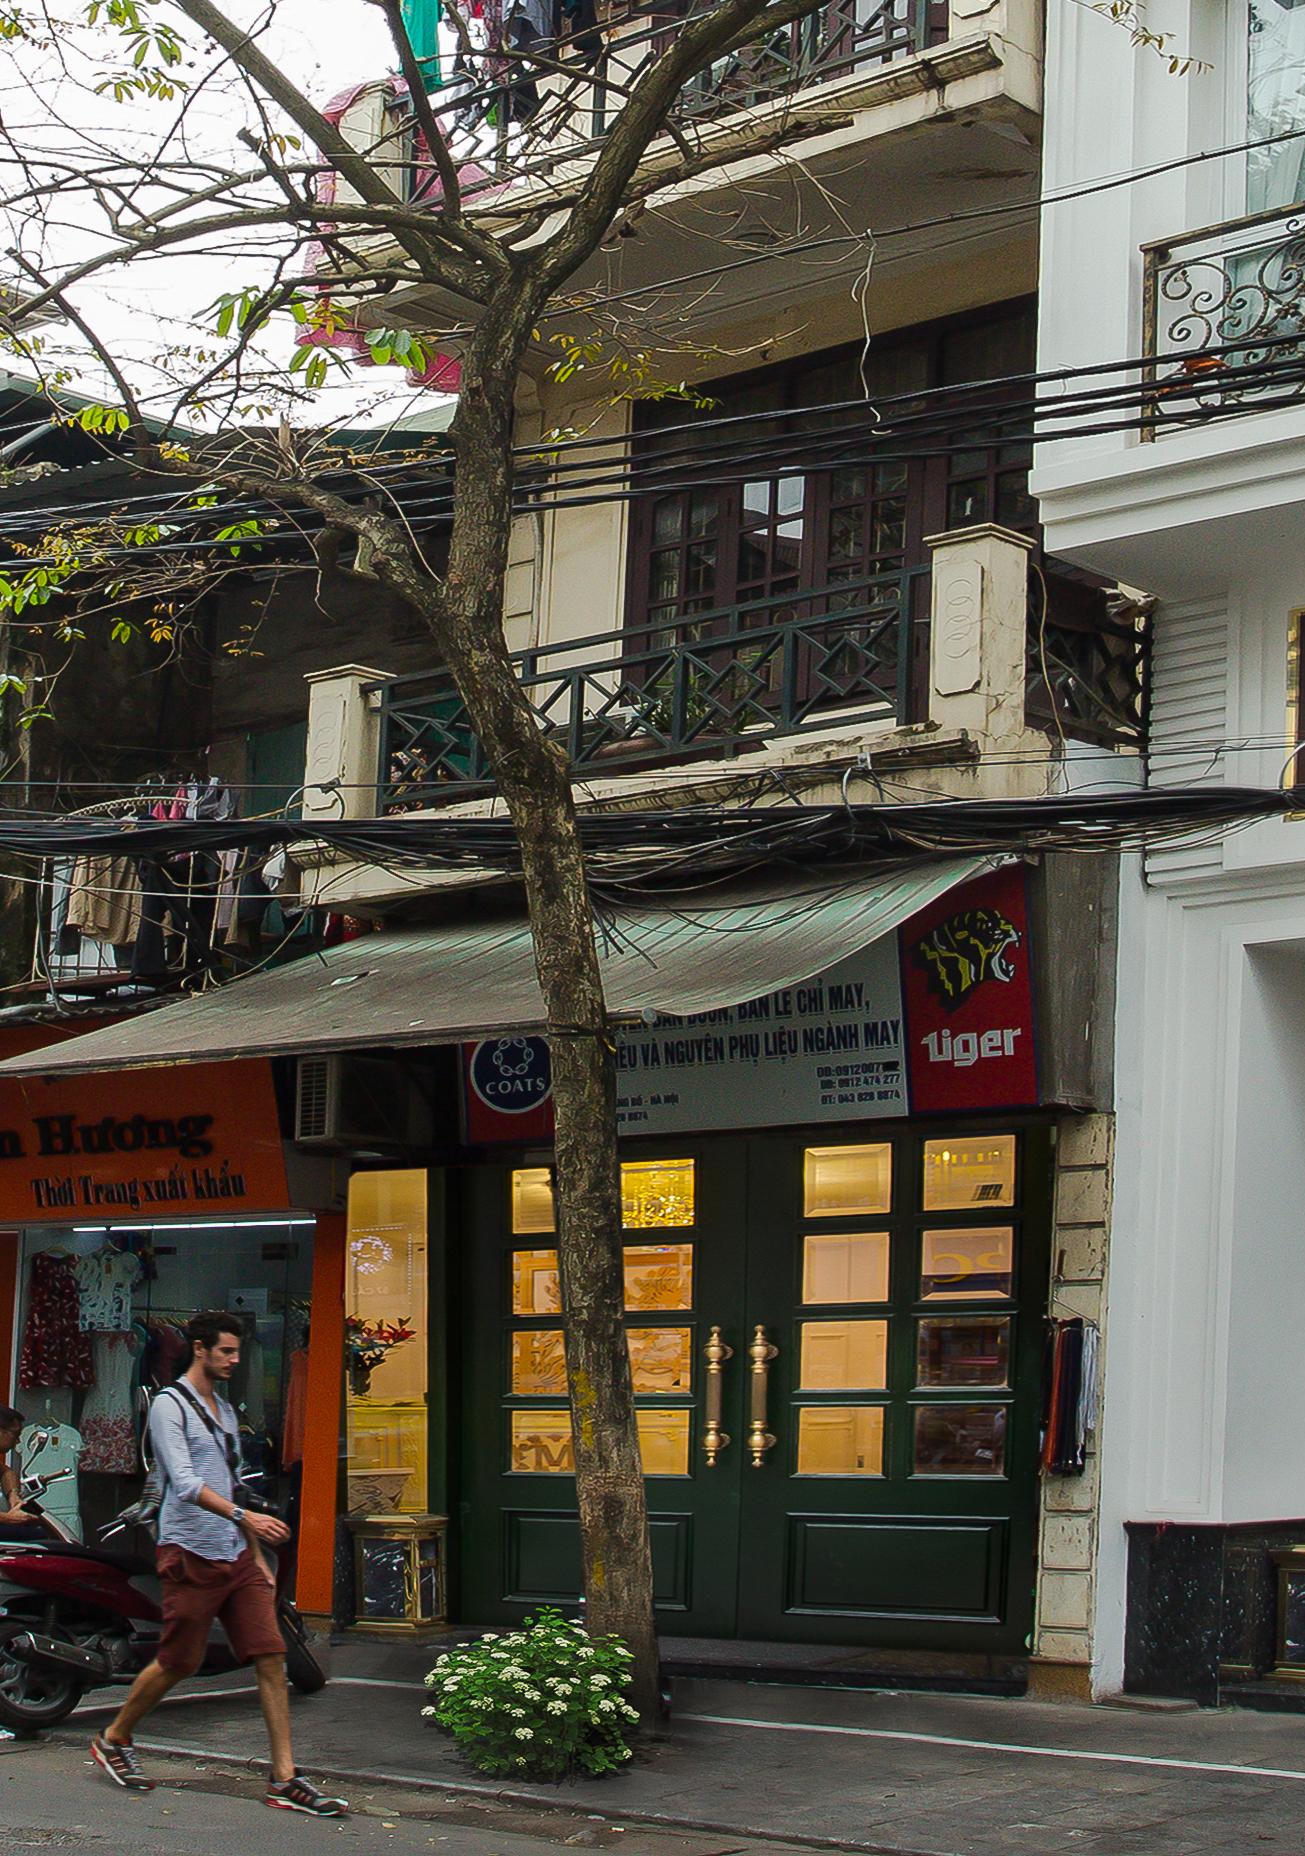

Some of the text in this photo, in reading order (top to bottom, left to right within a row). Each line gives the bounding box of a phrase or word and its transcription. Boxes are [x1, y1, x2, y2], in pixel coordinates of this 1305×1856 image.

[829, 983, 870, 1013] MAY,
[642, 1038, 660, 1066] VÀ
[664, 1032, 724, 1063] NGUYÊN
[729, 1034, 760, 1066] PHỤ
[803, 1021, 859, 1052] NGÀNH
[864, 1019, 900, 1047] MAY
[920, 1028, 1022, 1068] tiger
[486, 1077, 545, 1095] COATS
[32, 1114, 214, 1159] Hương
[32, 1159, 247, 1210] Thời Trang xuất khẩu
